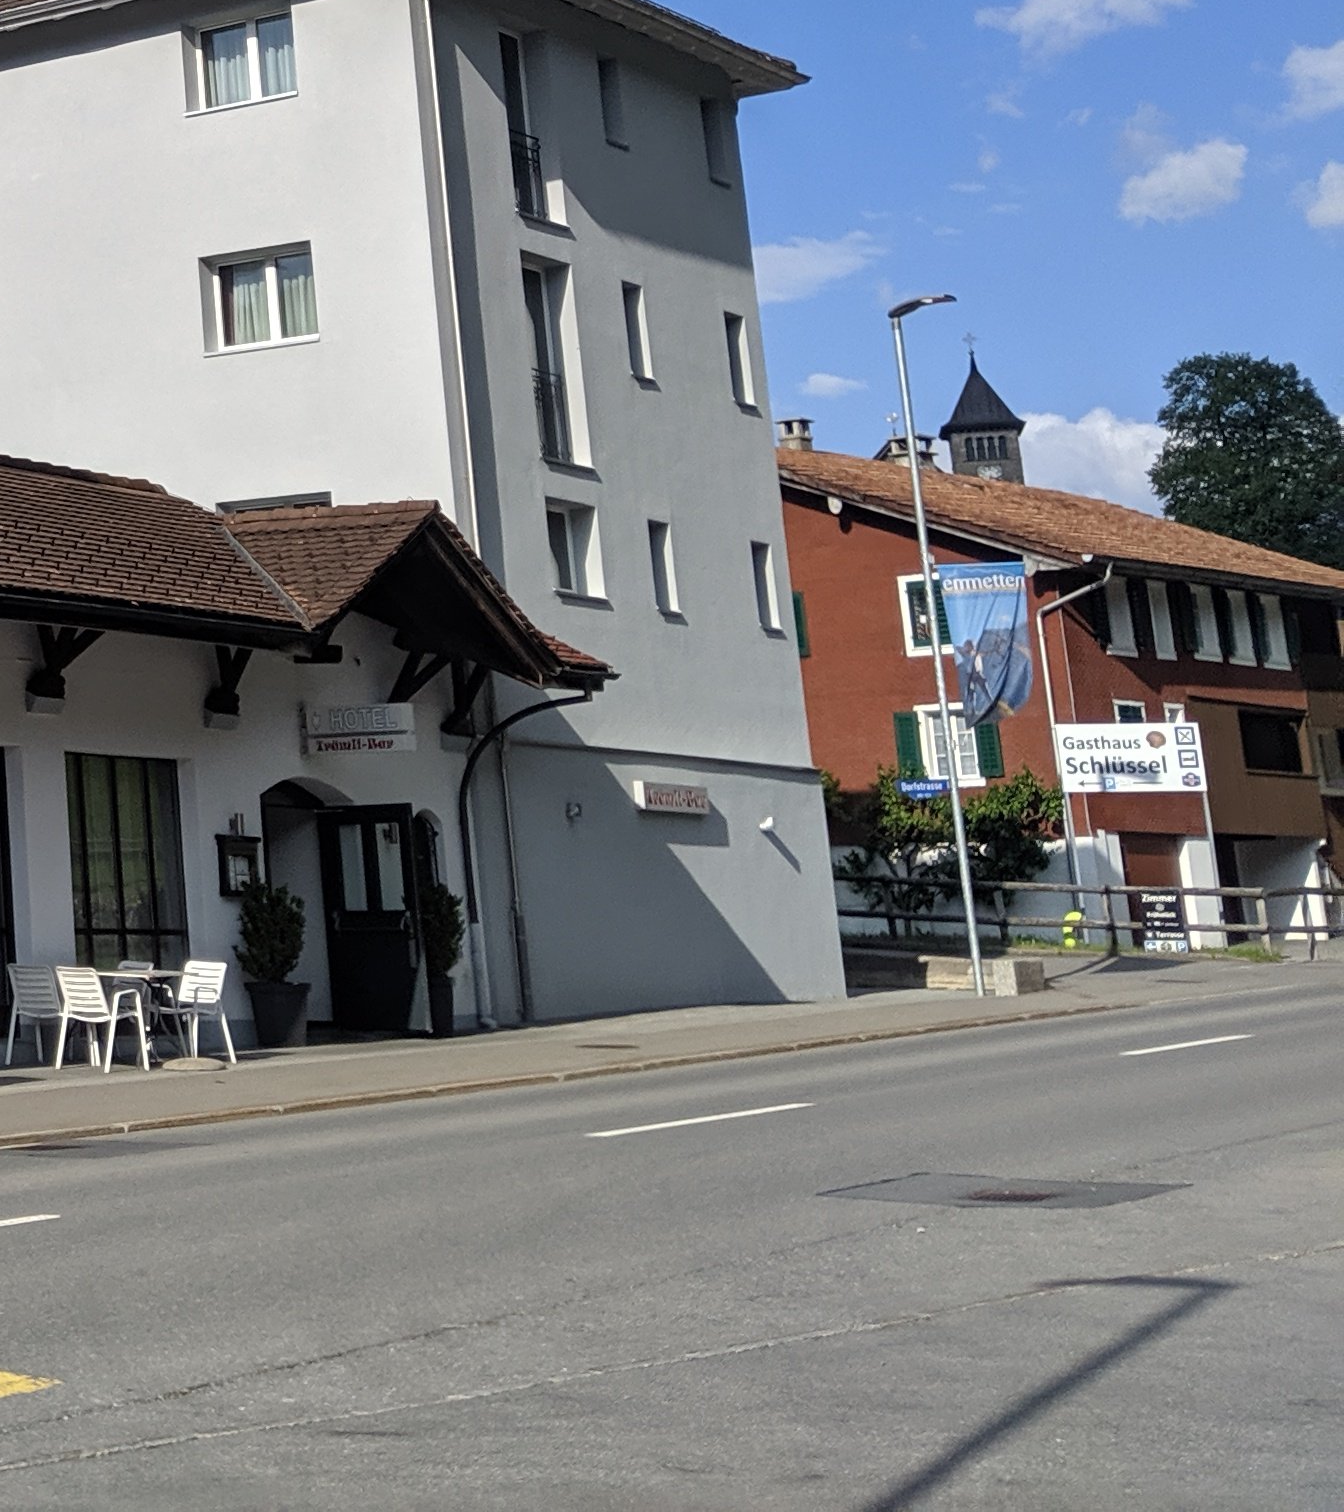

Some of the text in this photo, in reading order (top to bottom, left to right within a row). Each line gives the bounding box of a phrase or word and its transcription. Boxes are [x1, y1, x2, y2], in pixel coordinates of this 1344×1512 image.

[942, 573, 1025, 592] emmetten
[329, 706, 398, 731] HOTEL
[1062, 736, 1142, 750] Gasthaus
[1065, 754, 1168, 775] Schlüssel
[1141, 893, 1177, 903] Zimmer
